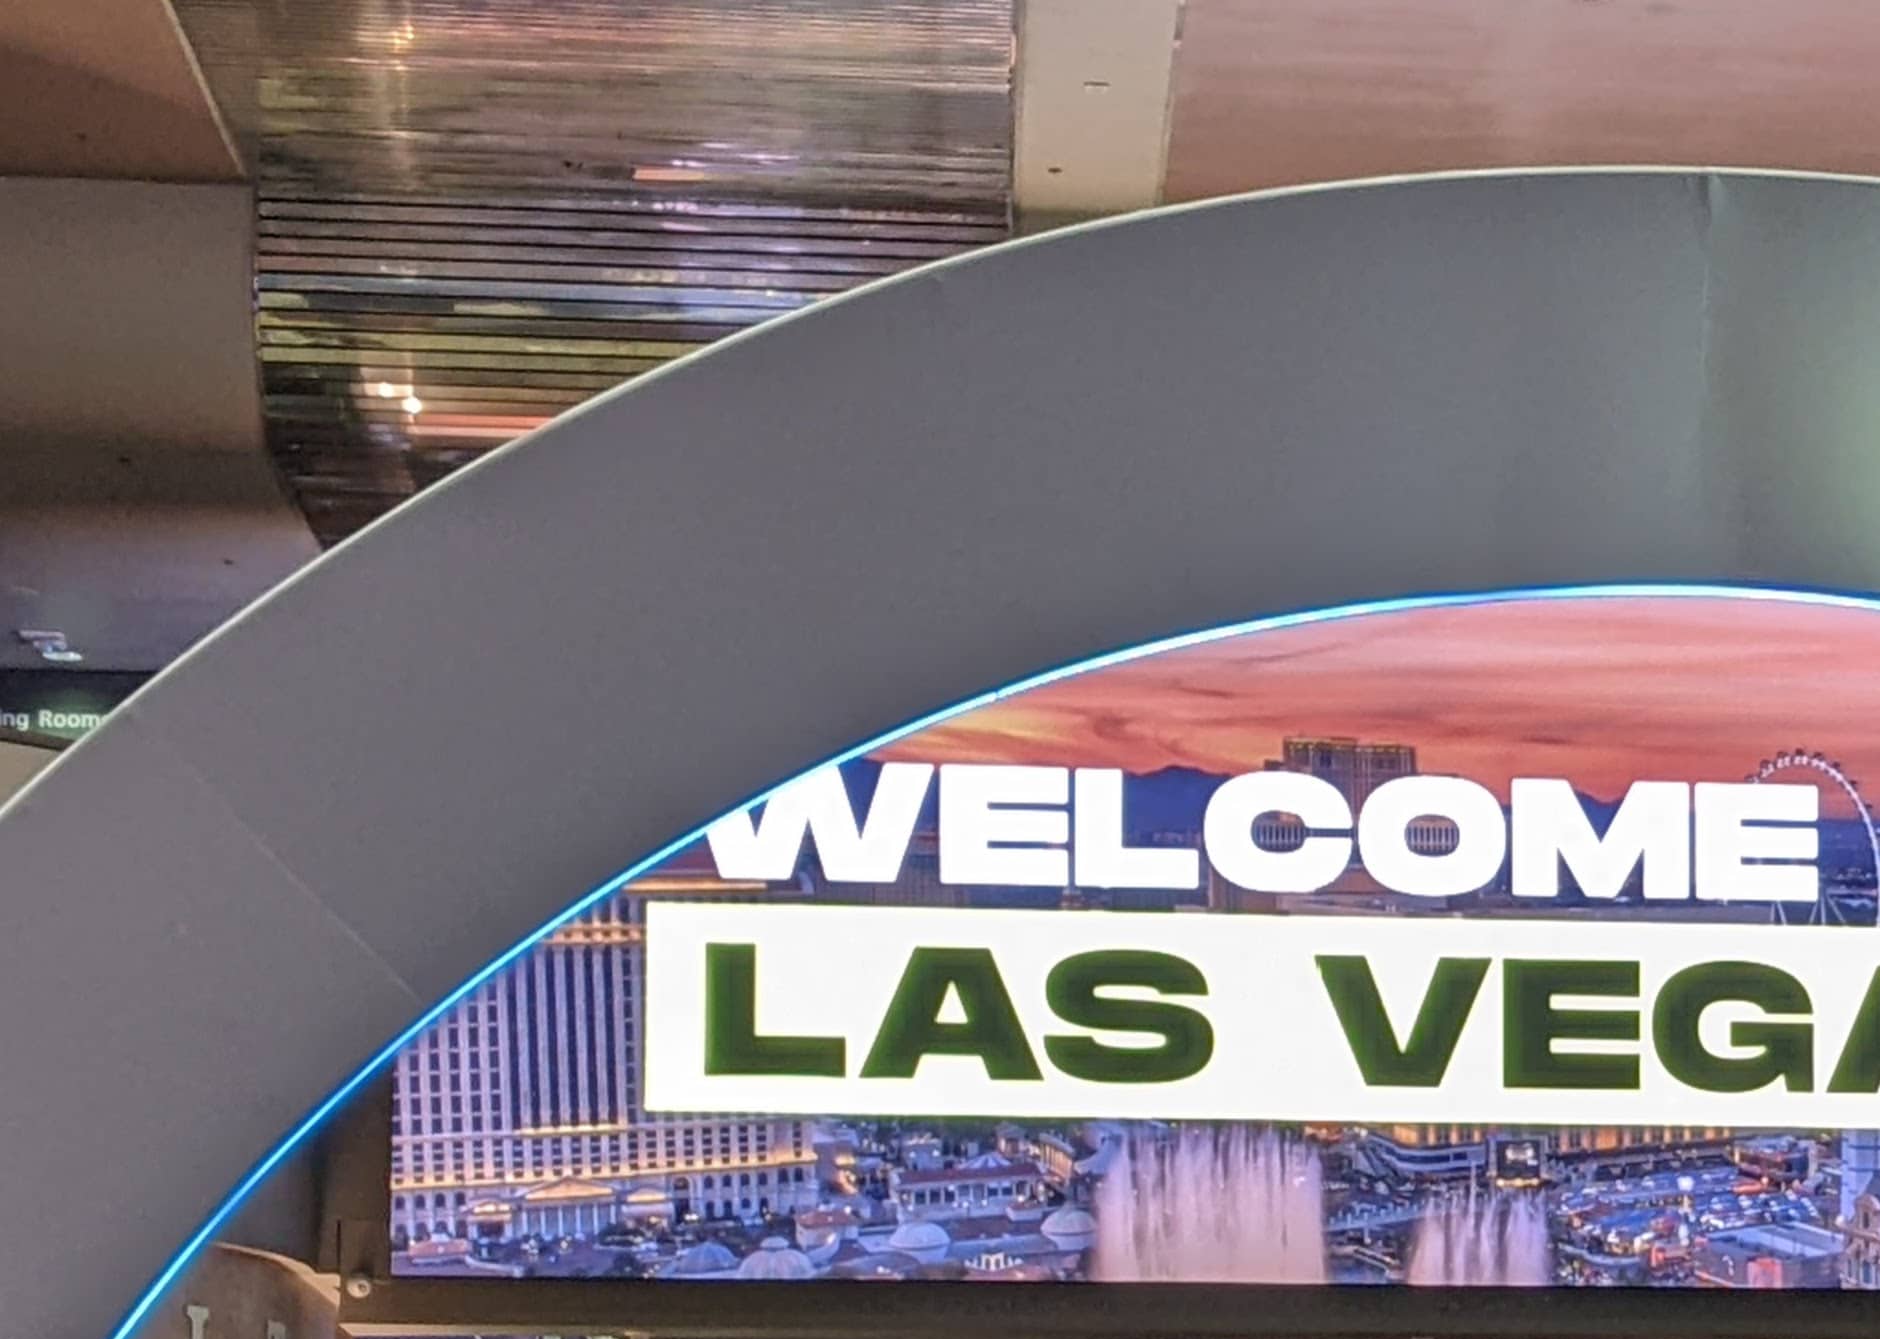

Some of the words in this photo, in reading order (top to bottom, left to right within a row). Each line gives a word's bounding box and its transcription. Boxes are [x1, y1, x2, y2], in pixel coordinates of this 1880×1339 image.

[38, 708, 104, 729] Room
[704, 760, 1820, 902] WELCOME
[704, 942, 1213, 1083] LAS
